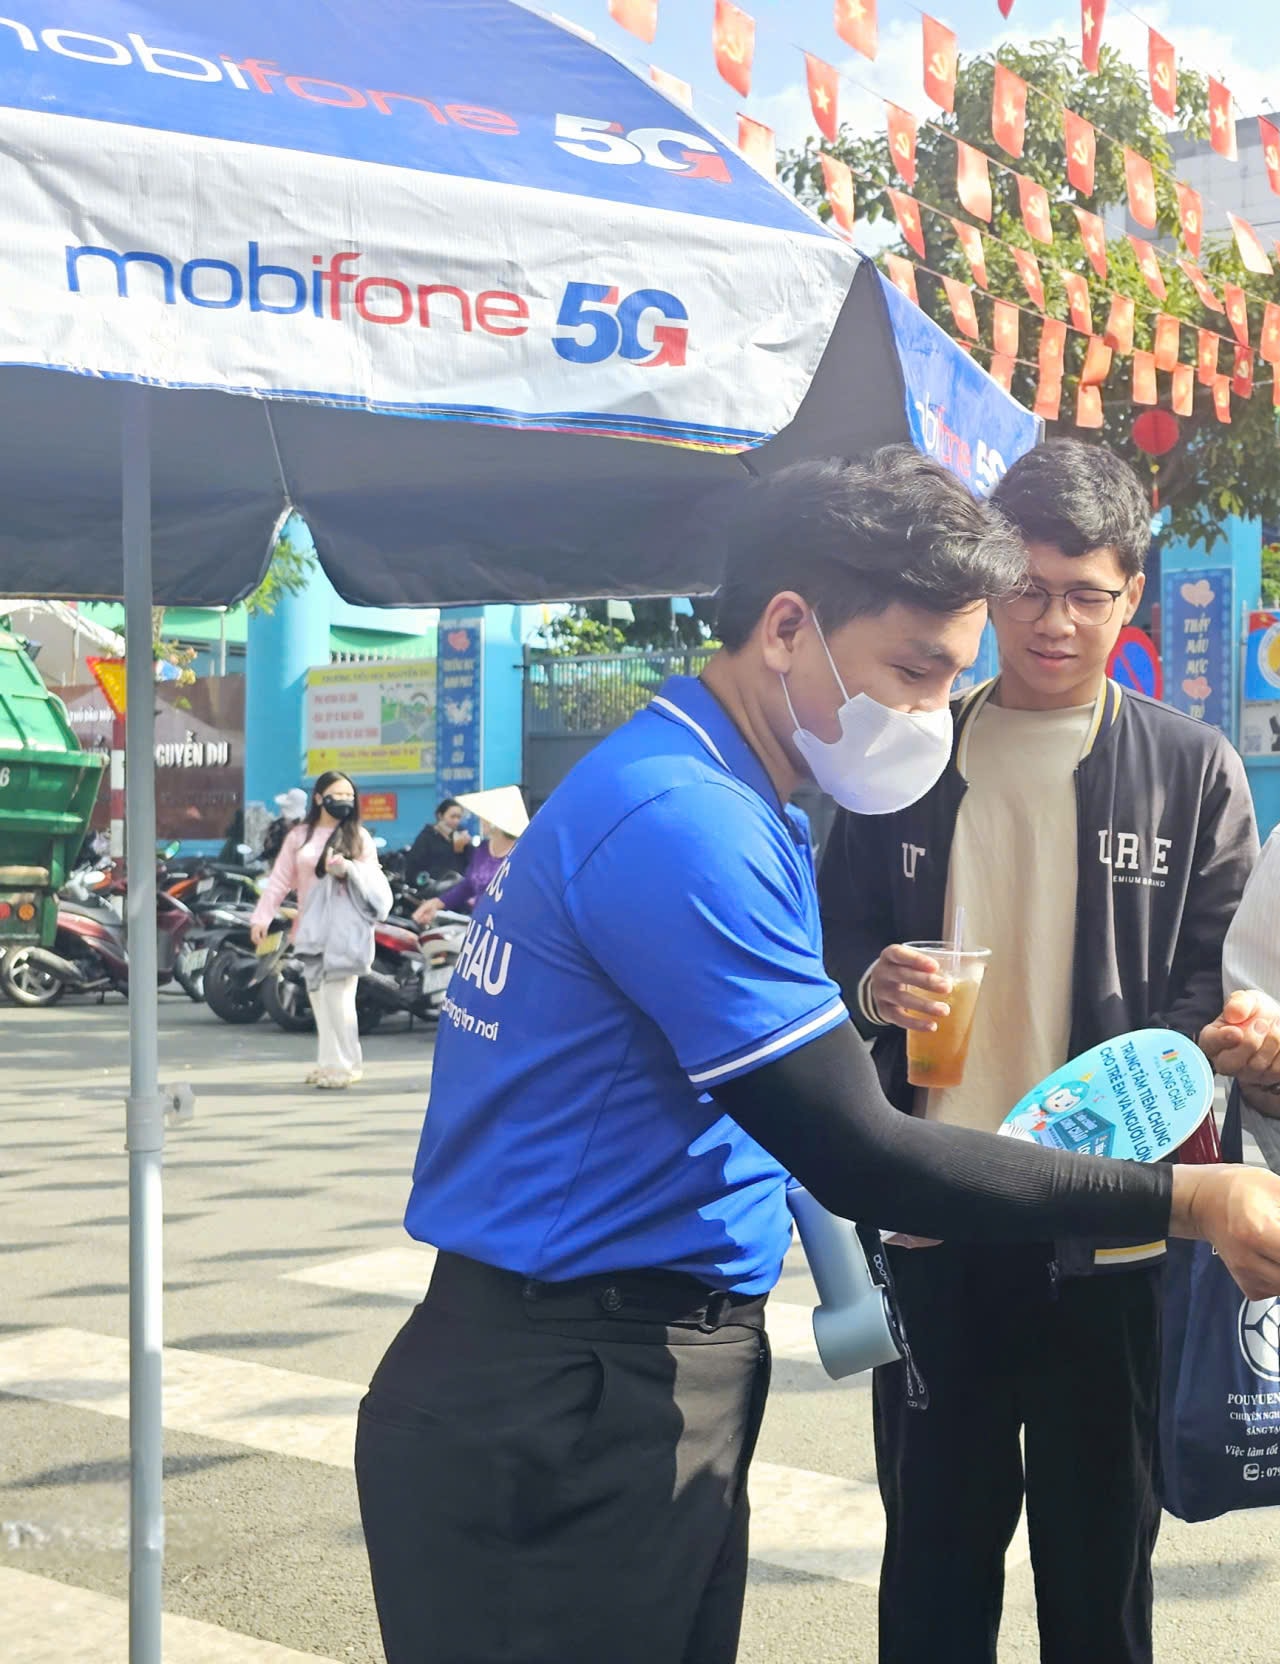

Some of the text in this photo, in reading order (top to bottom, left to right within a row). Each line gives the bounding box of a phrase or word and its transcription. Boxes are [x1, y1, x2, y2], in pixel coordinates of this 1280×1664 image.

[554, 113, 732, 183] 5G
[65, 241, 689, 367] mobifone 5G
[156, 730, 230, 768] GUYỄN DU
[1112, 875, 1142, 885] EMIUM
[455, 913, 513, 996] HÂU
[475, 1019, 499, 1042] nơi
[1099, 1046, 1116, 1068] CHO
[1112, 1080, 1127, 1096] EM
[1119, 1040, 1172, 1148] TRUNG TÂM TIÊM CHỦNG
[1159, 1067, 1187, 1111] LONG CHÂU
[1118, 1094, 1134, 1112] VÀ
[1122, 1110, 1147, 1146] NGƯỜI
[1230, 1411, 1262, 1422] CHUYÊN
[1246, 1425, 1268, 1436] SÁNG
[1225, 1445, 1245, 1457] Việc
[1247, 1446, 1264, 1457] làm
